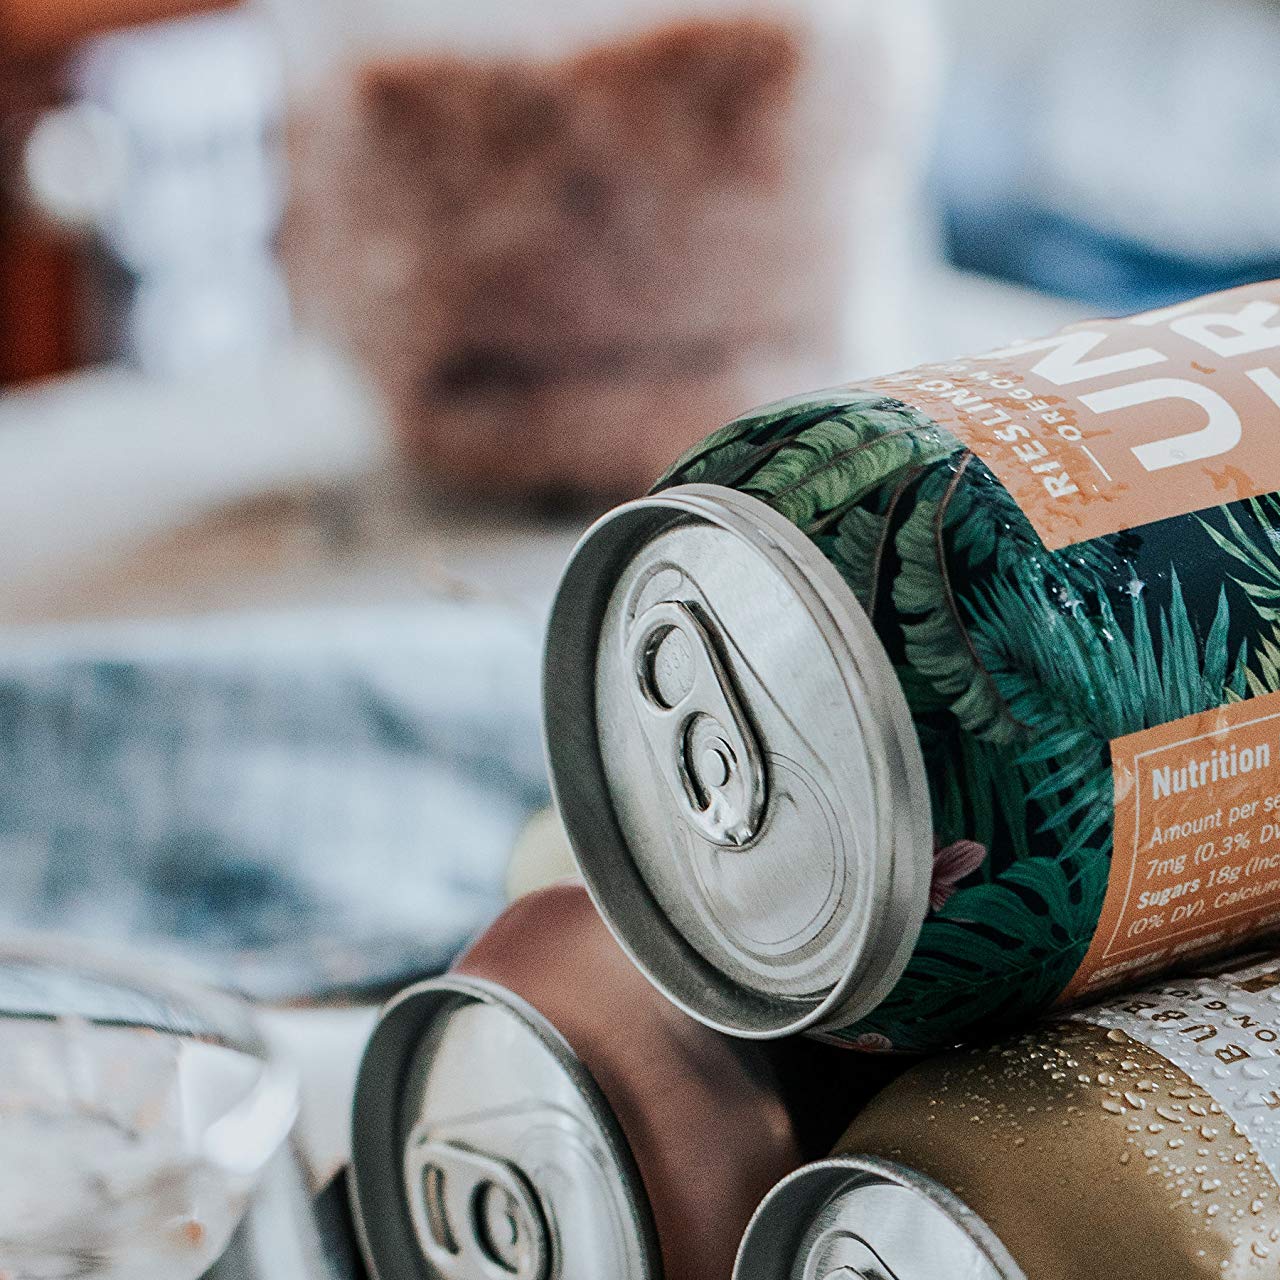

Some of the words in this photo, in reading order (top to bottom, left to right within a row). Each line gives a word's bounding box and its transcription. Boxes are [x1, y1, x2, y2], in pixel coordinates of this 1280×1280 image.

[968, 370, 1082, 441] OREGON
[916, 379, 1078, 498] RIESLING
[1152, 743, 1270, 800] Nutrition
[1150, 808, 1222, 848] Amount
[1229, 800, 1259, 827] per
[1146, 854, 1187, 880] 7mg
[1194, 832, 1251, 865] (0.3%
[1137, 878, 1200, 909] Sugars
[1205, 865, 1241, 888] 18g
[1127, 911, 1165, 938] (0%
